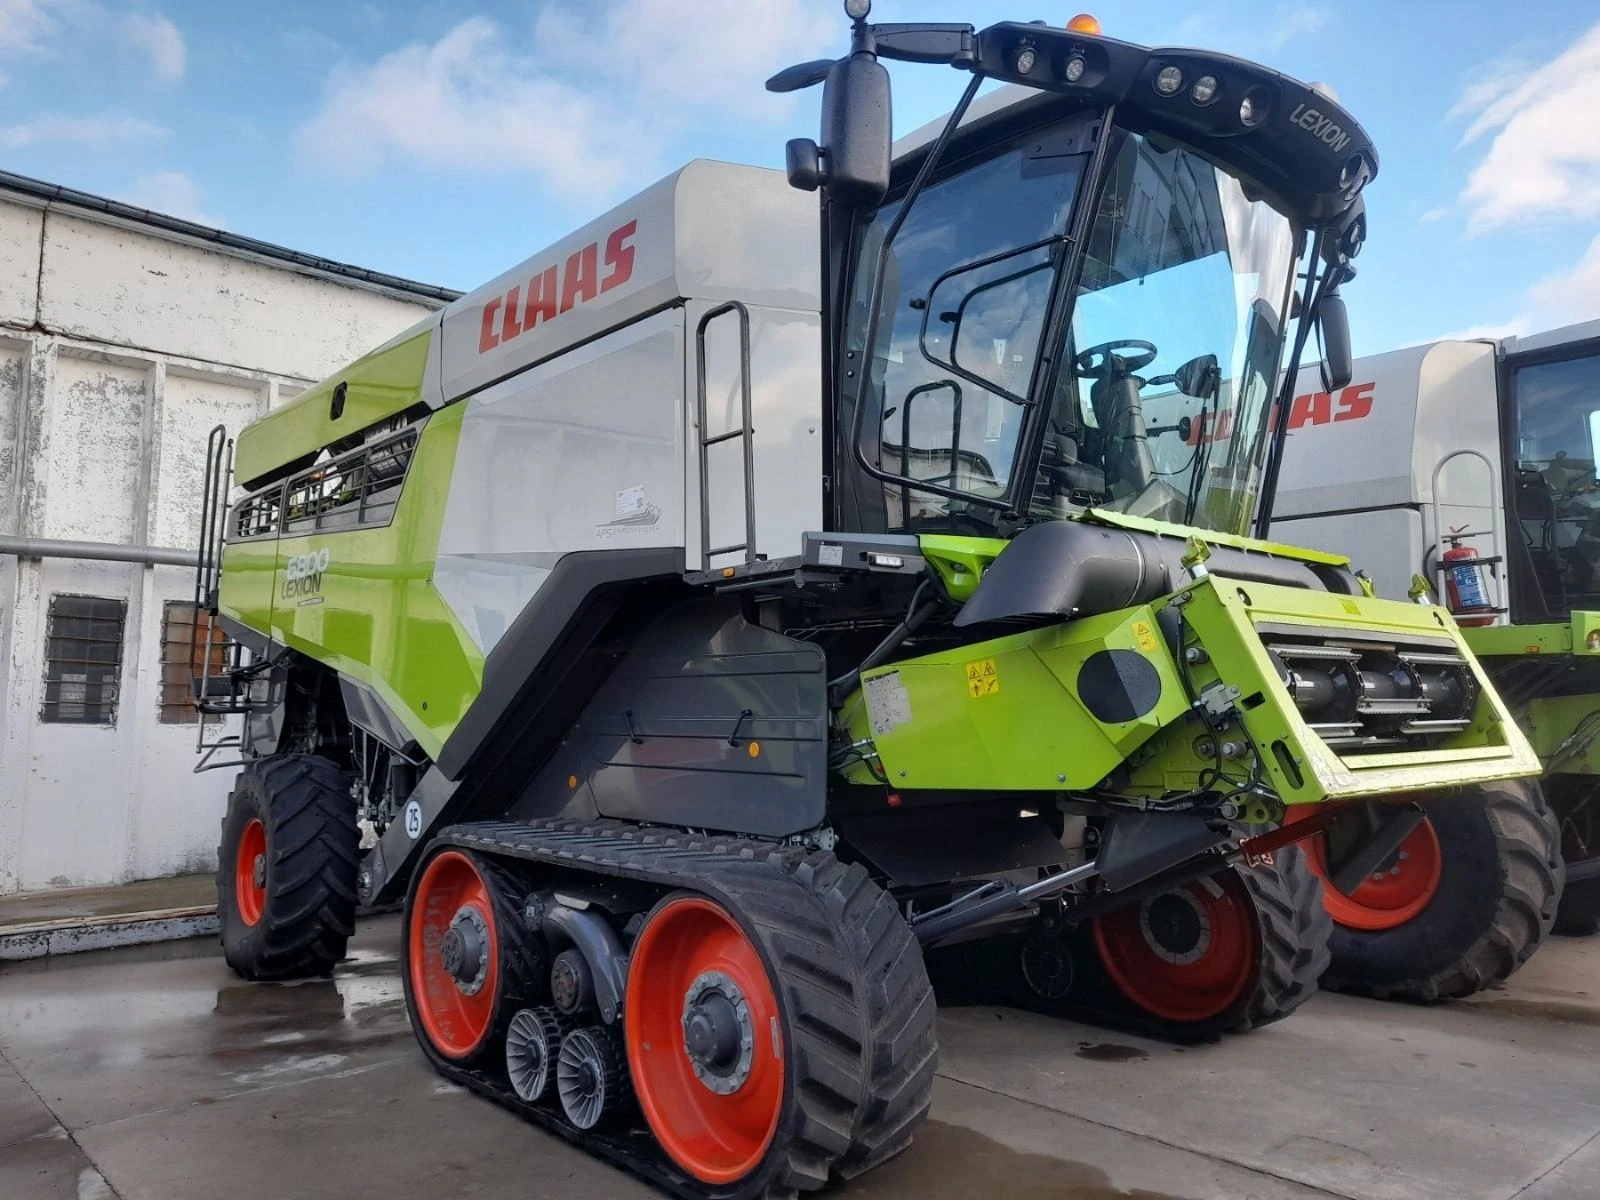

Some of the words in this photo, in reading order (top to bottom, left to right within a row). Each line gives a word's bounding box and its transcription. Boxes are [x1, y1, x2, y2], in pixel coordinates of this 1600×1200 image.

[1289, 103, 1351, 153] LEXION
[479, 219, 637, 355] CLAAS
[1187, 382, 1376, 446] CLAS
[281, 571, 322, 600] LEXION
